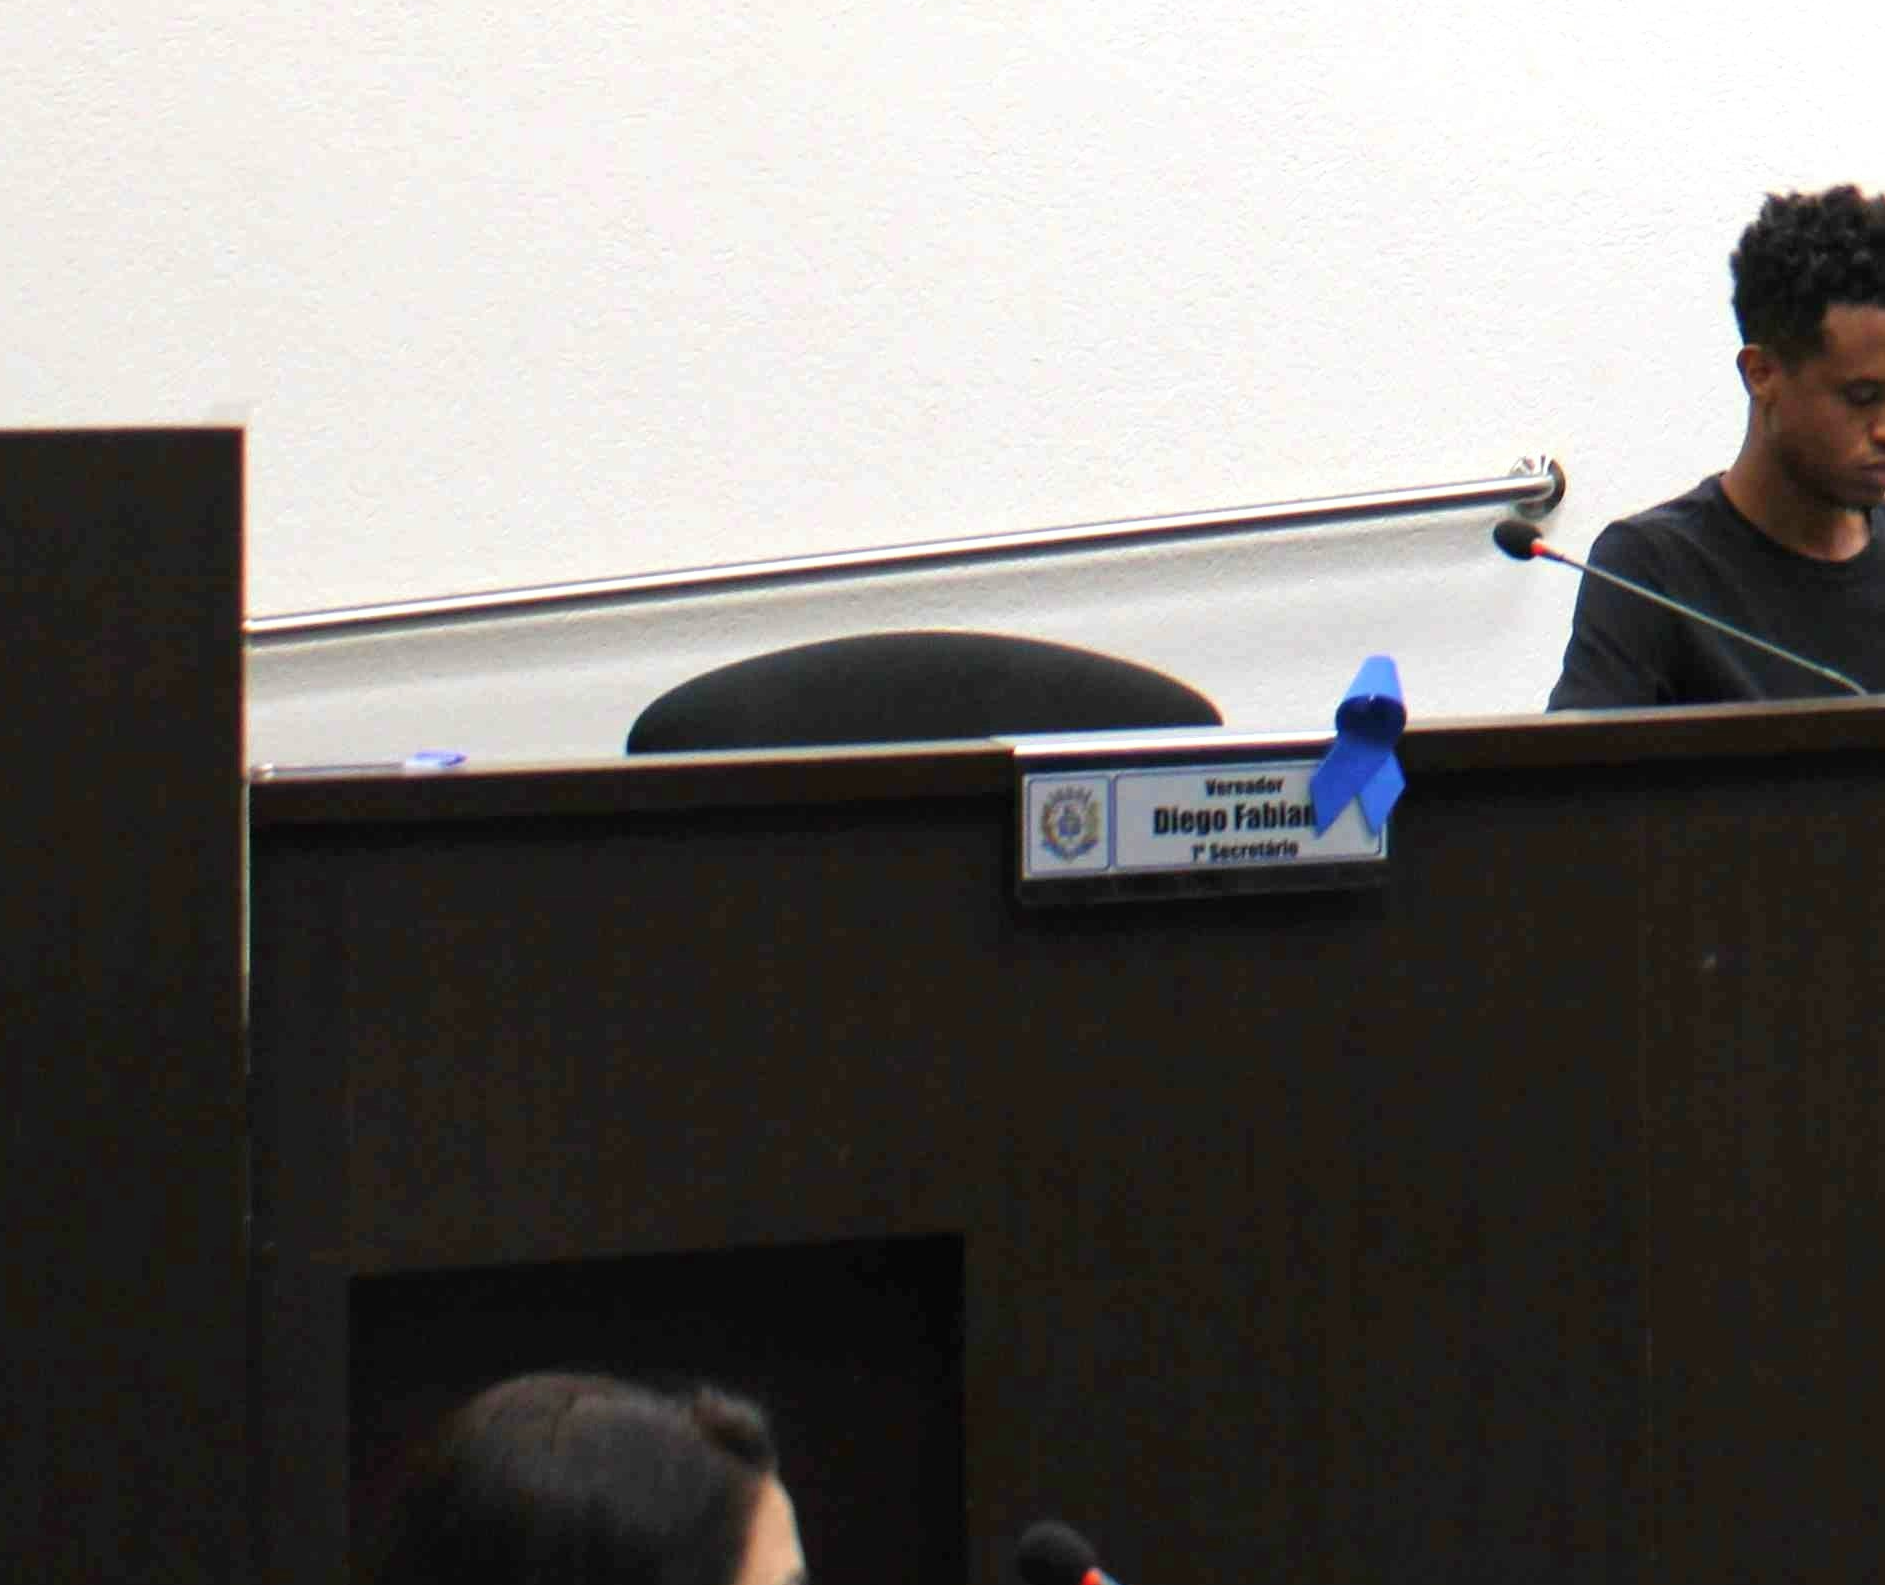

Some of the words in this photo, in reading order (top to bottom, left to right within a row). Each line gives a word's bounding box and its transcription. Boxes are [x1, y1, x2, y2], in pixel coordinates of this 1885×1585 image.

[1205, 776, 1284, 796] Vereador
[1153, 806, 1227, 836] Diego
[1209, 839, 1299, 861] Secretário
